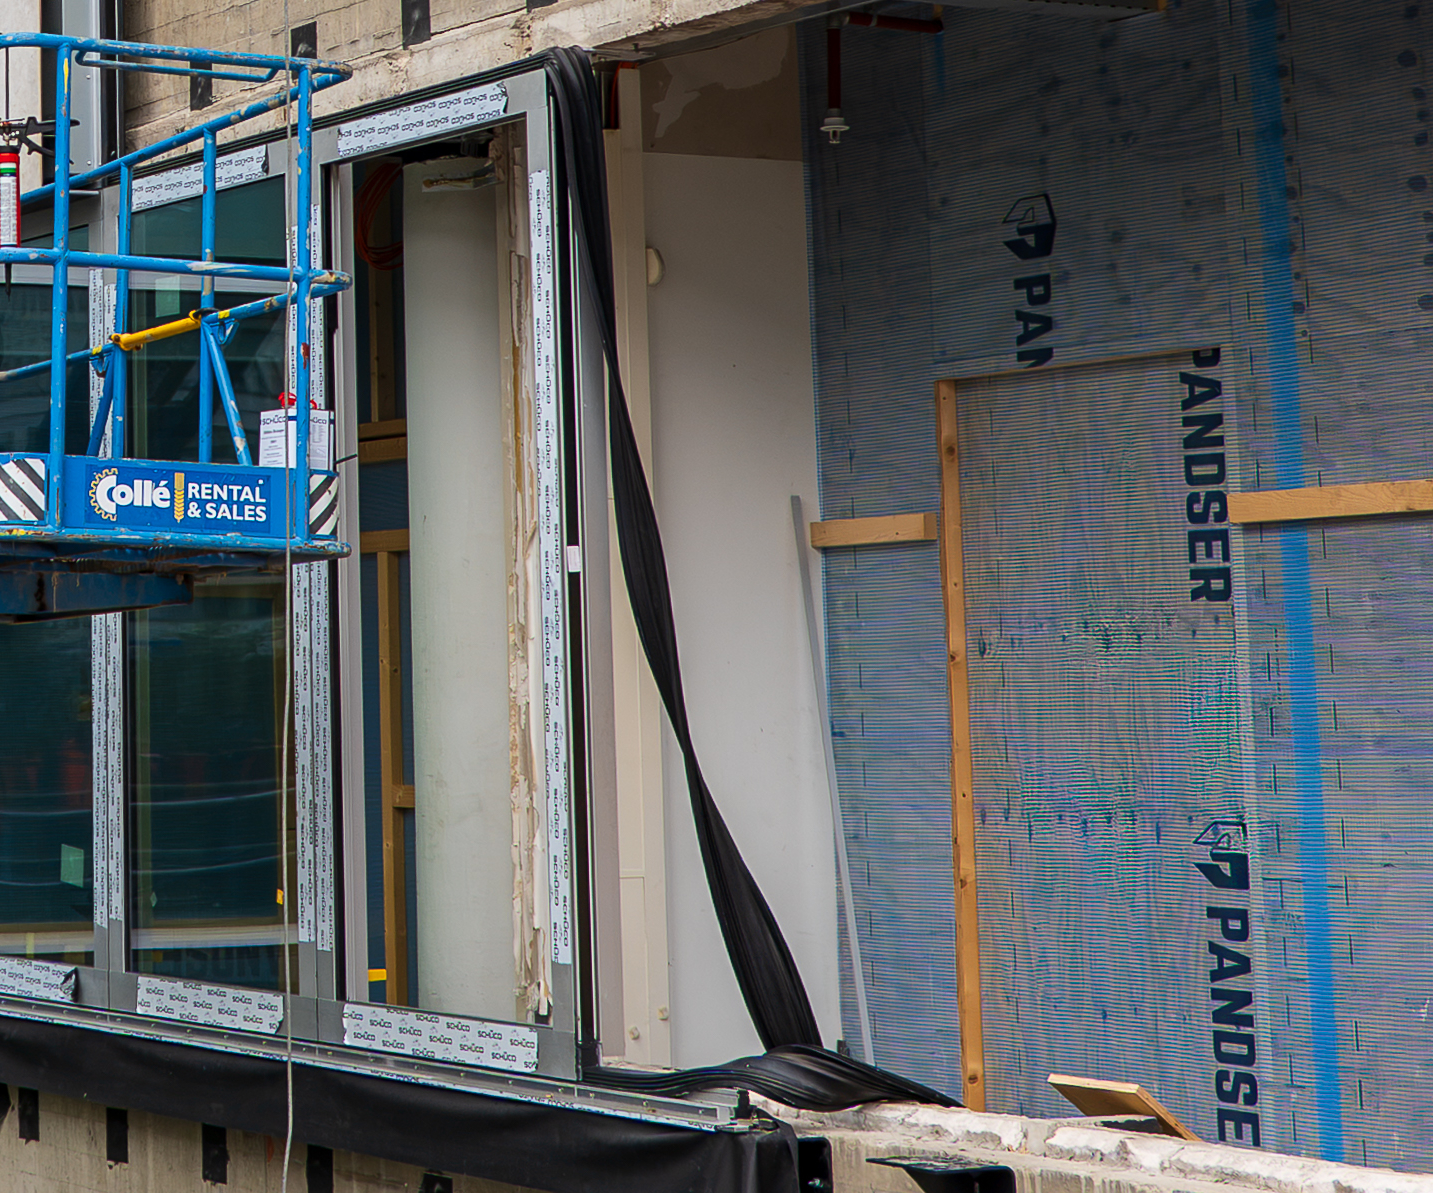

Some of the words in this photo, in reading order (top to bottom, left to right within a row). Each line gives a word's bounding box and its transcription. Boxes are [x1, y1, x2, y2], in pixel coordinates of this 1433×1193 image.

[96, 475, 171, 514] Collé
[188, 482, 267, 503] RENTAL
[187, 502, 202, 518] &
[205, 503, 267, 522] SALES
